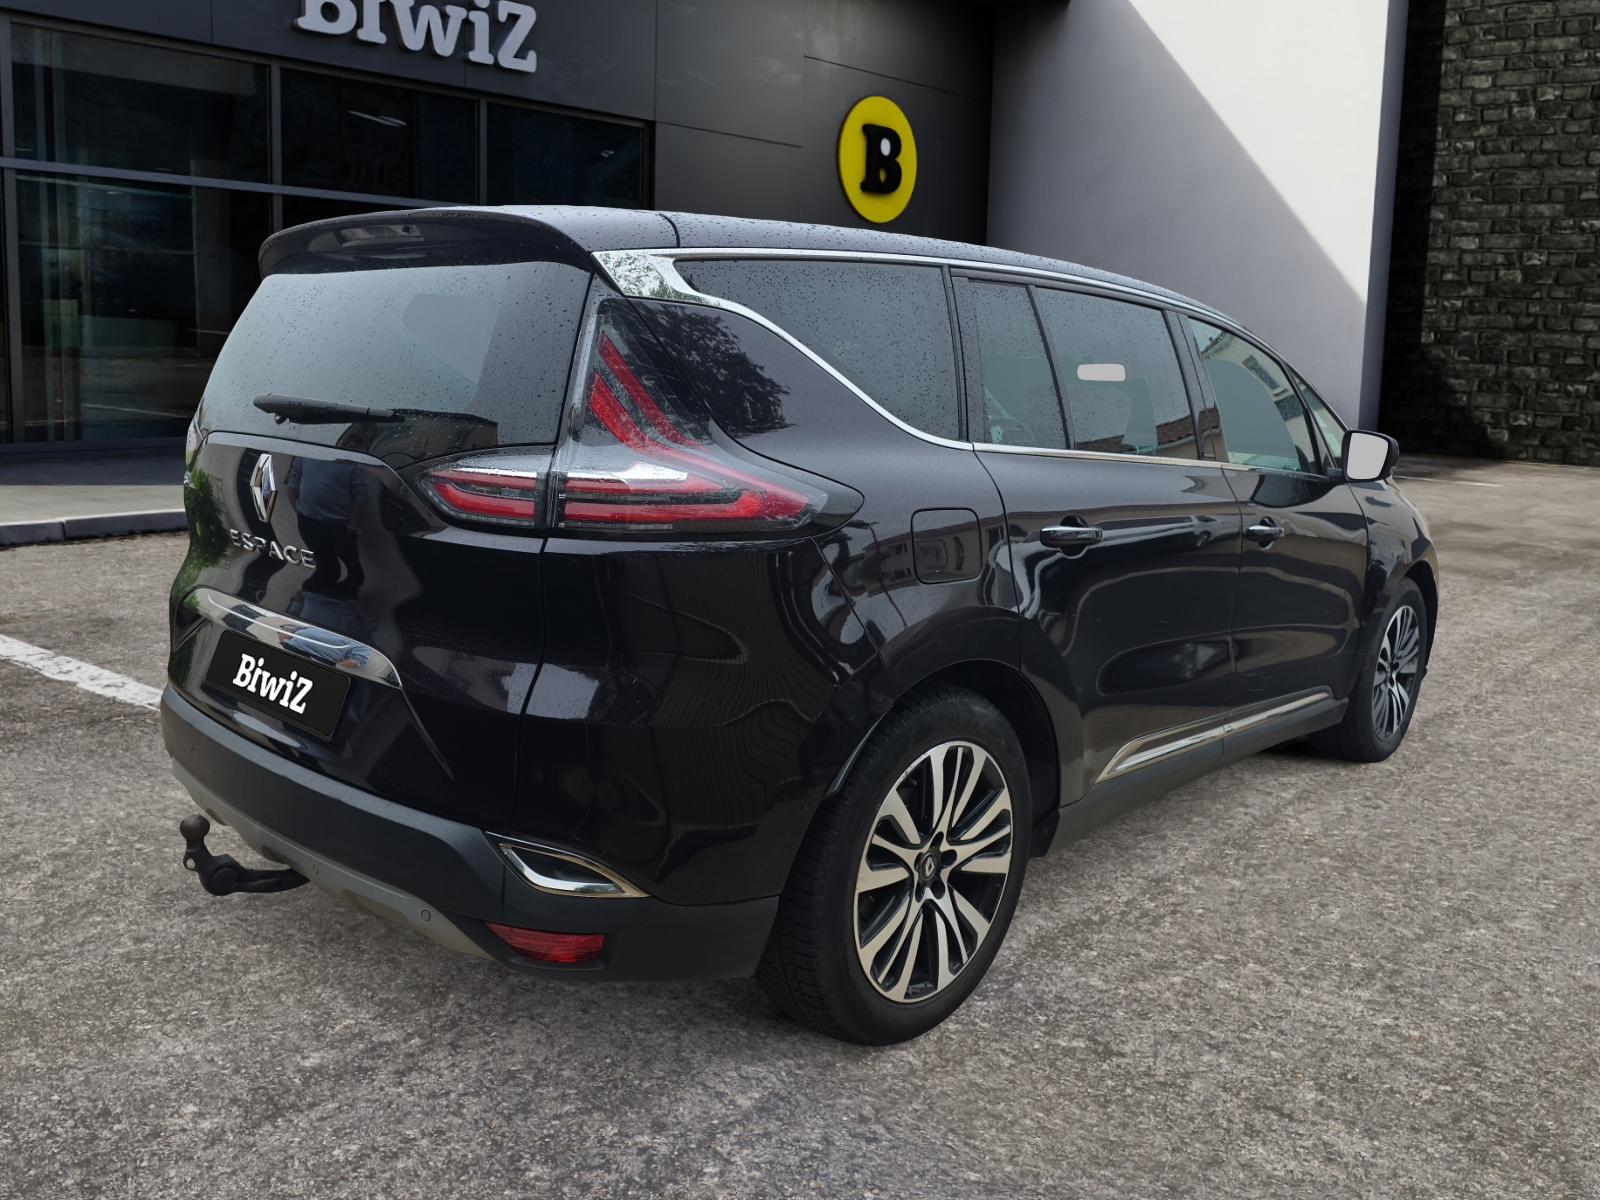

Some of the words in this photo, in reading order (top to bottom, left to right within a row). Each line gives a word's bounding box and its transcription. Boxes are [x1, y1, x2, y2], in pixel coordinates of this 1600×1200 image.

[860, 123, 903, 195] B
[229, 528, 317, 569] ESPACE
[232, 653, 314, 715] BiwiZ
